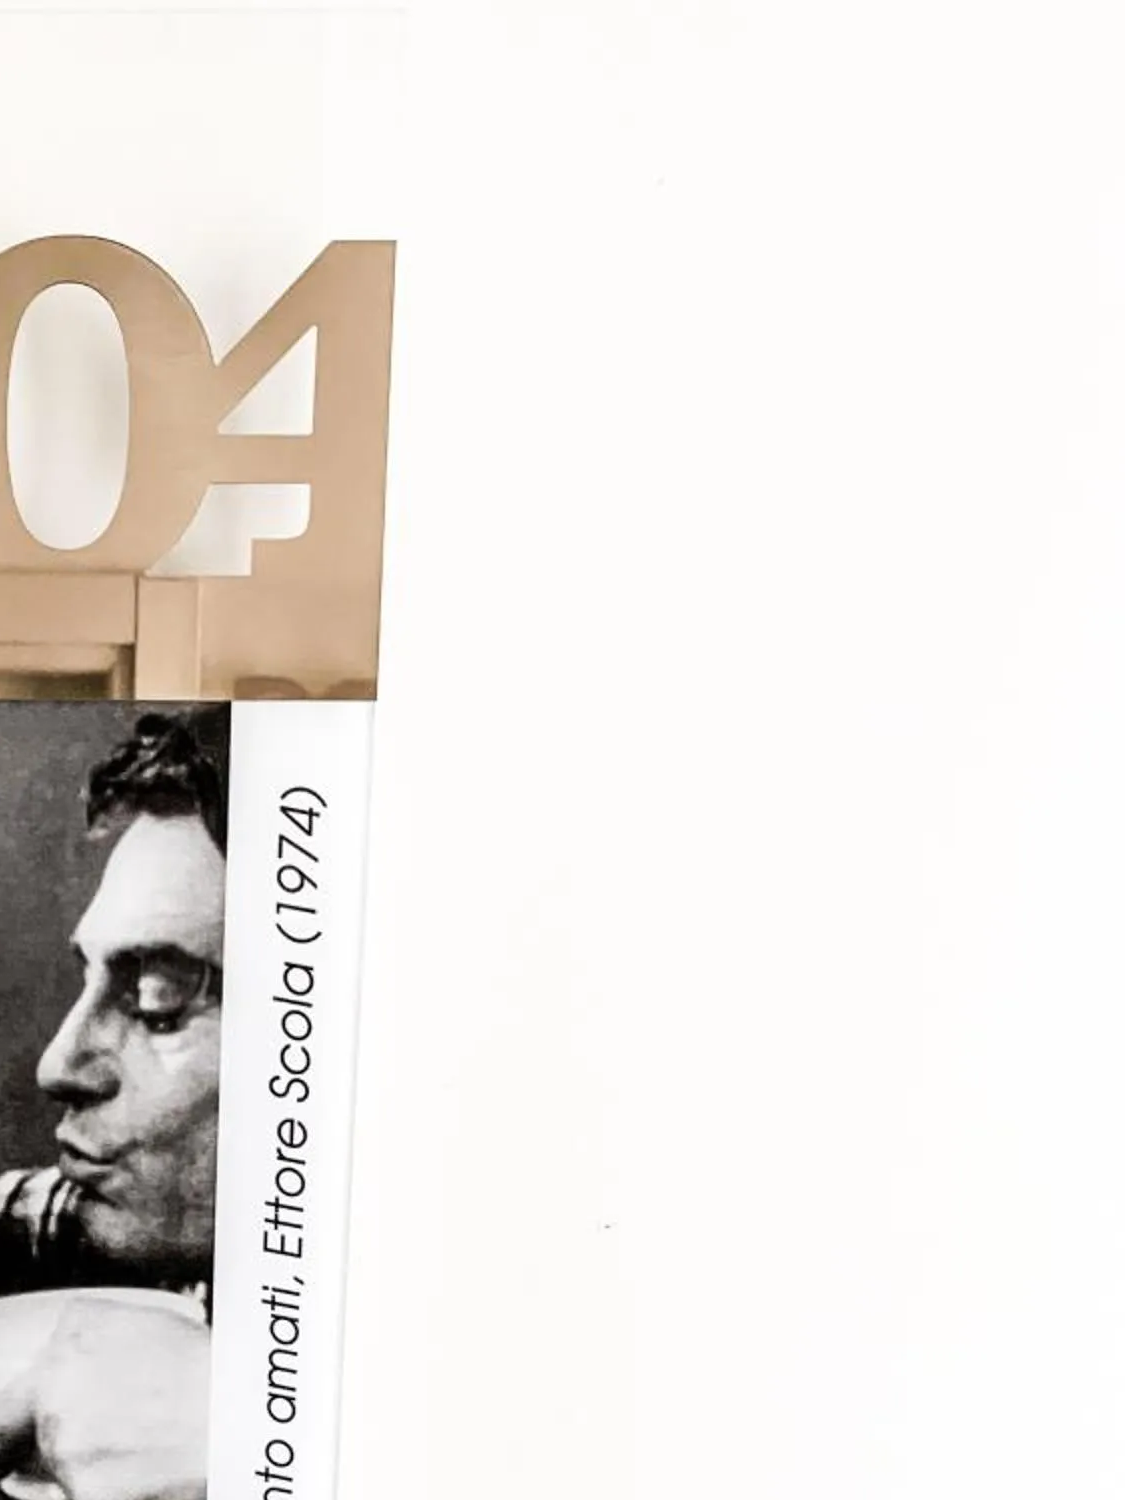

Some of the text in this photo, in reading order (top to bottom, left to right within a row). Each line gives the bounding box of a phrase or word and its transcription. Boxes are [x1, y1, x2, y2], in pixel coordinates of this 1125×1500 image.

[274, 785, 329, 945] (1974)
[267, 960, 316, 1104] Scola
[262, 1117, 309, 1260] Ettore
[260, 1275, 306, 1425] amati,
